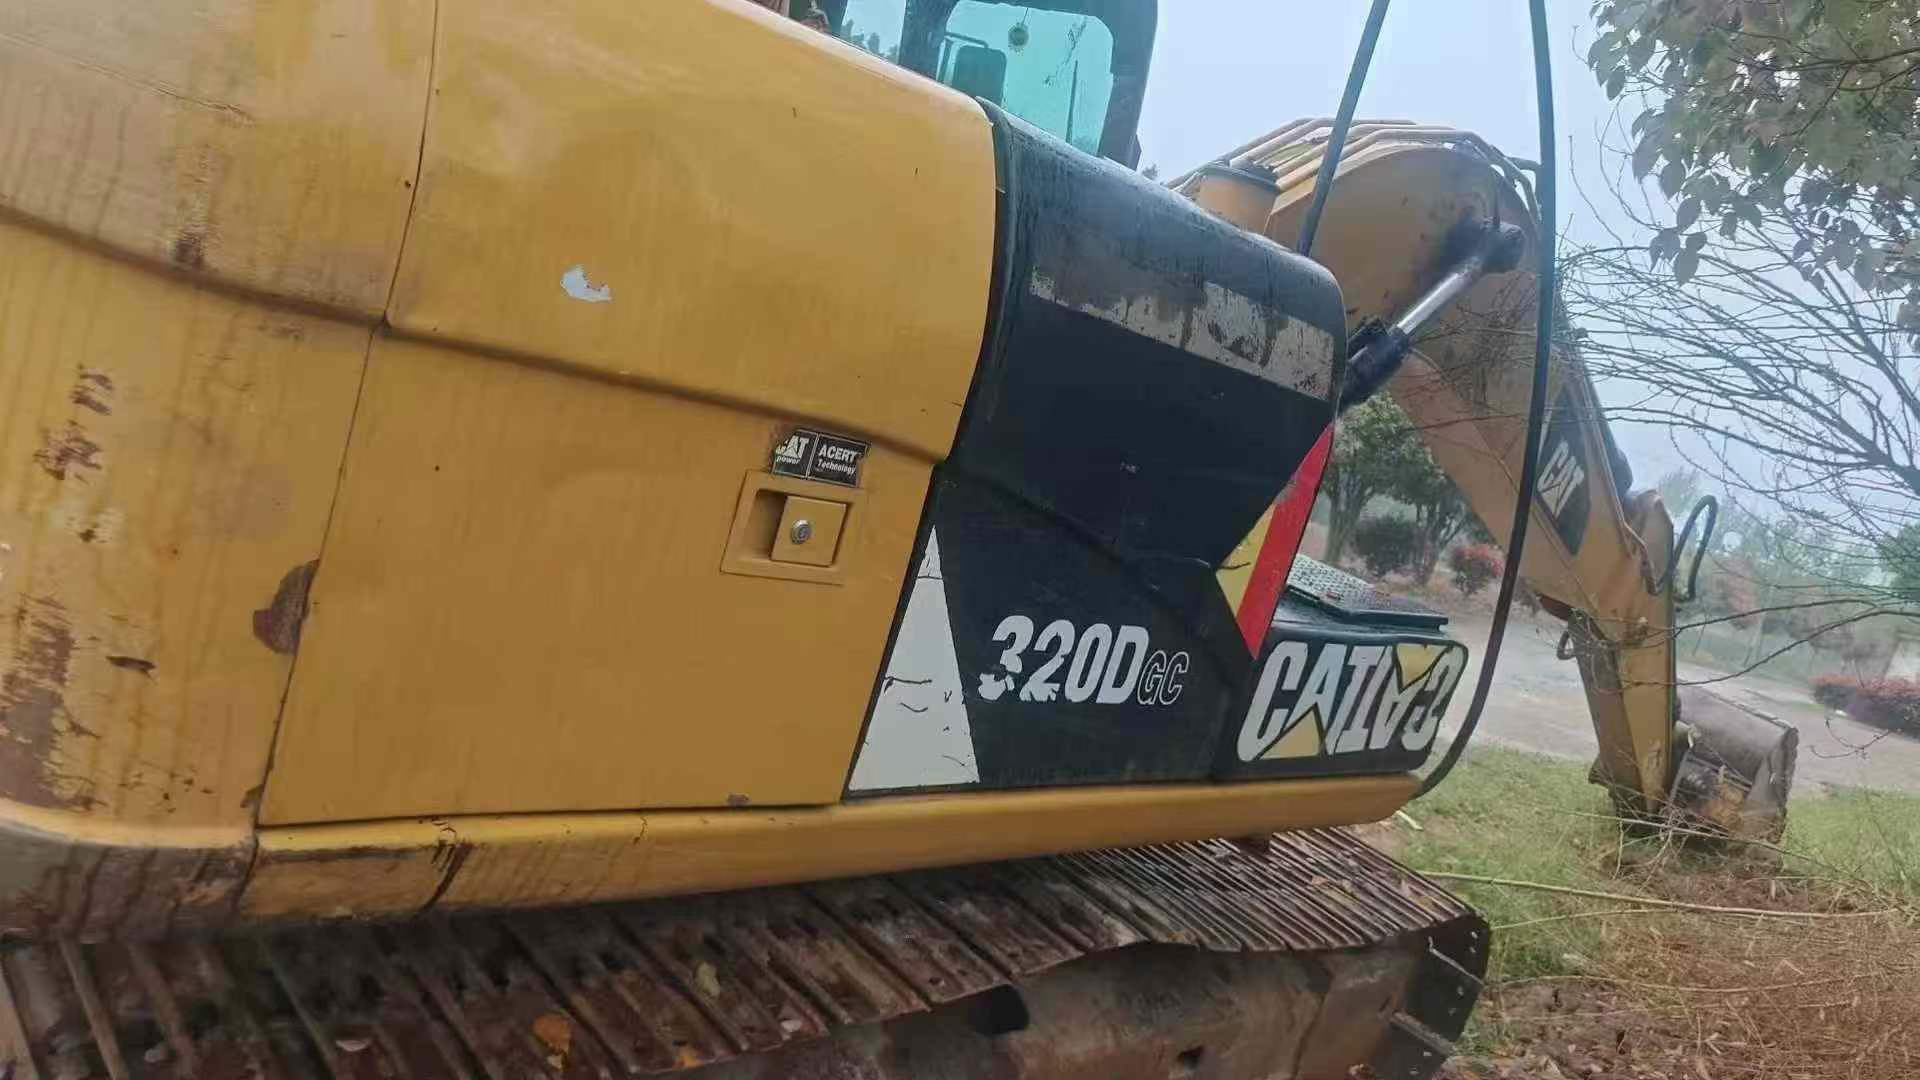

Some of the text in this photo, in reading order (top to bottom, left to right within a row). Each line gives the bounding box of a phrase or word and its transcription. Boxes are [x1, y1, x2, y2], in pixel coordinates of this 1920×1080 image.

[776, 455, 800, 464] power
[818, 444, 858, 463] ACERT
[817, 458, 857, 475] Technology
[1537, 441, 1585, 520] CAT
